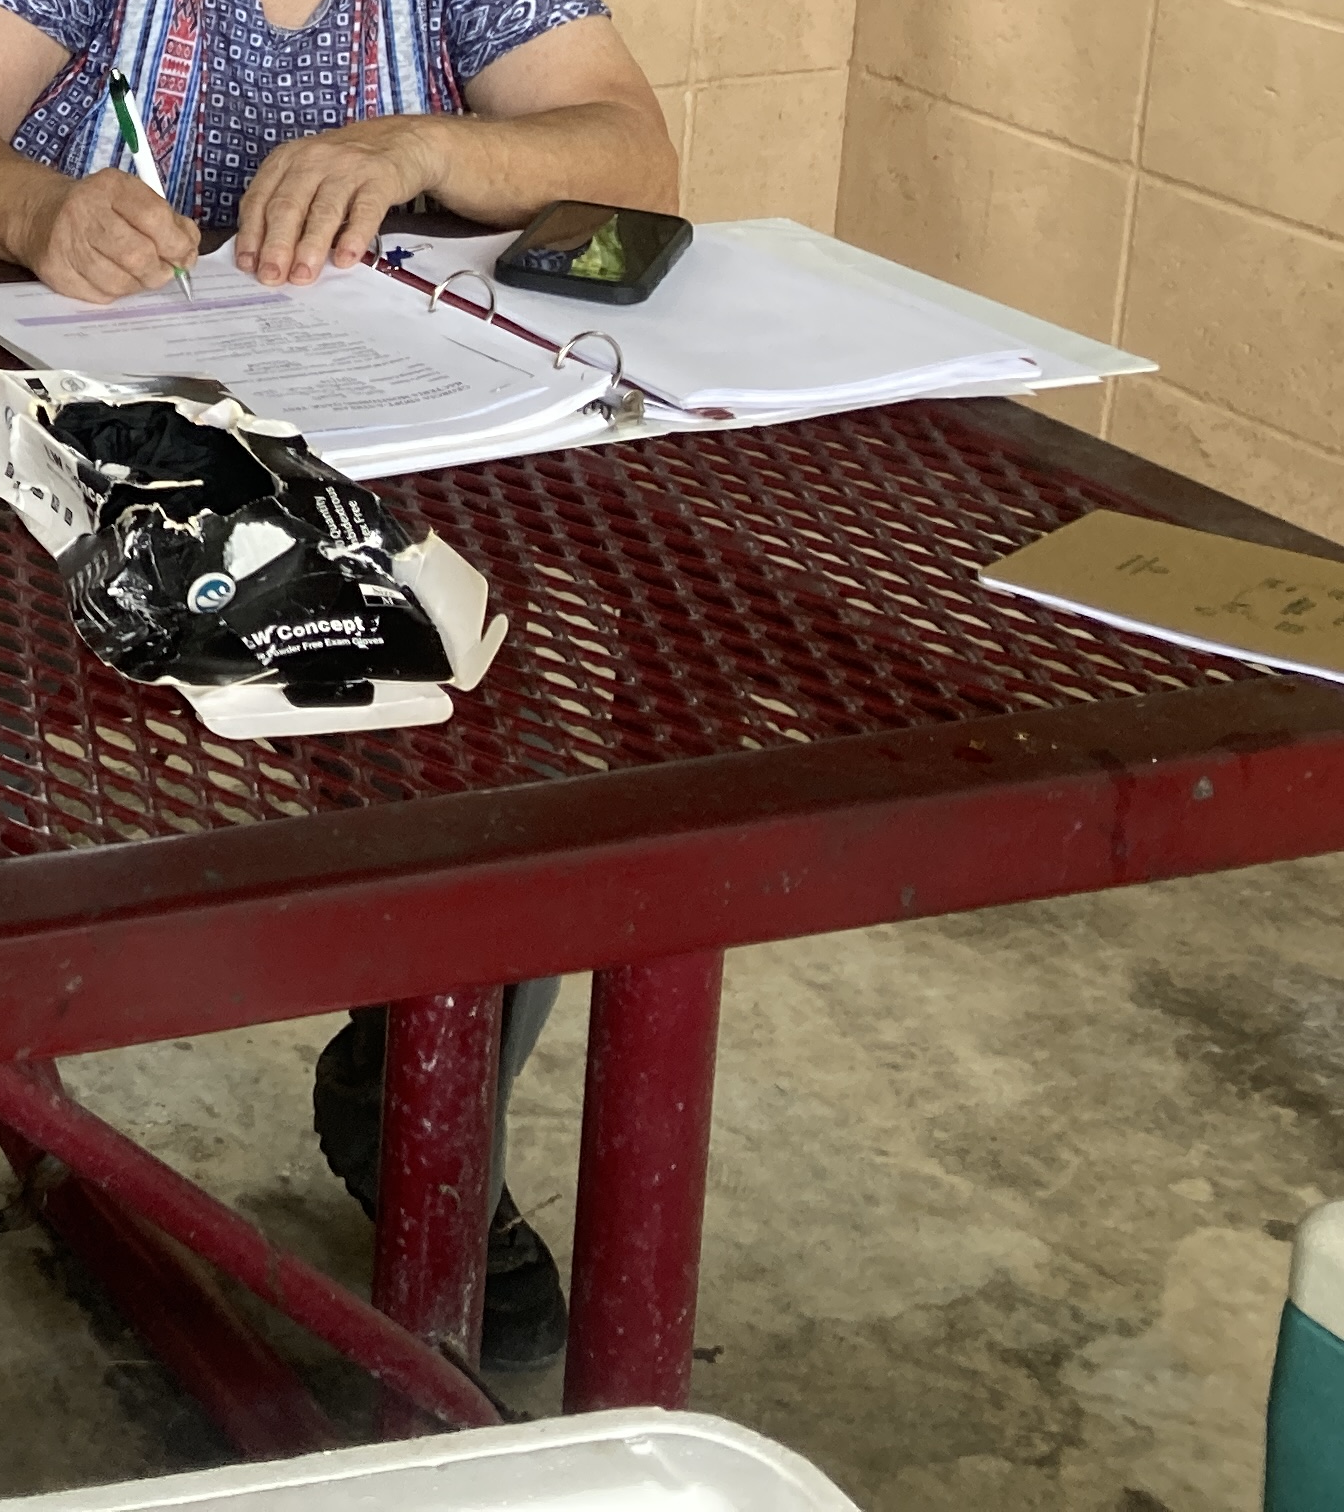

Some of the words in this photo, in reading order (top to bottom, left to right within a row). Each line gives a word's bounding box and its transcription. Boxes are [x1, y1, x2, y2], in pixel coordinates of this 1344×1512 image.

[314, 495, 342, 539] Quantity
[325, 486, 359, 545] bidextrous
[348, 500, 365, 524] Free
[381, 596, 394, 607] M
[276, 615, 366, 641] Concept
[302, 640, 324, 652] Free
[324, 637, 352, 649] Exam
